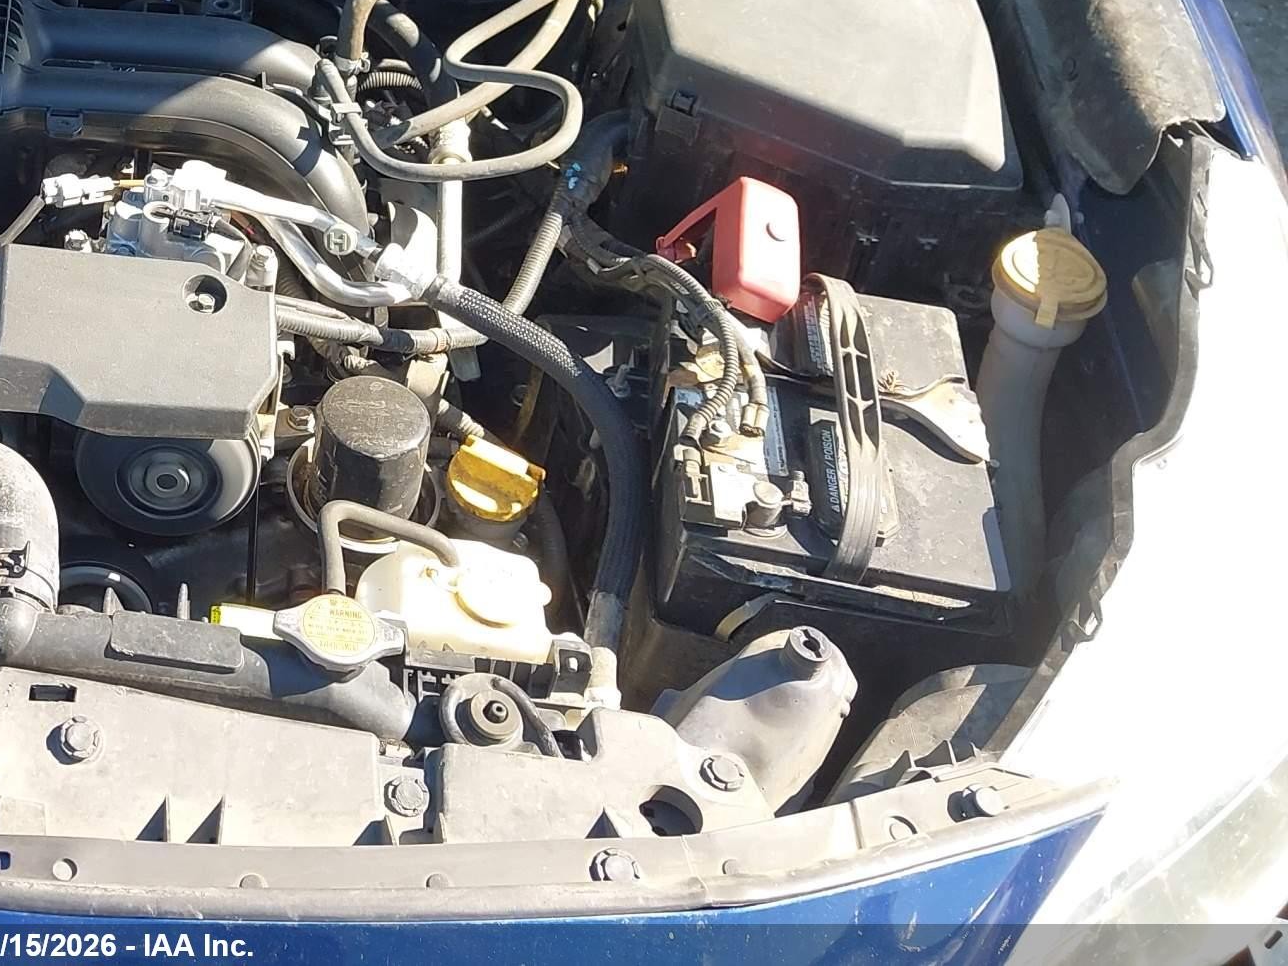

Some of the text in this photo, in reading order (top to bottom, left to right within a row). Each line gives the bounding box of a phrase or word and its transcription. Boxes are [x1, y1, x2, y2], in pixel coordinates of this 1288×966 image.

[329, 232, 348, 251] H
[822, 429, 834, 461] POISON
[826, 468, 840, 505] DANGER
[329, 609, 362, 619] WARNING
